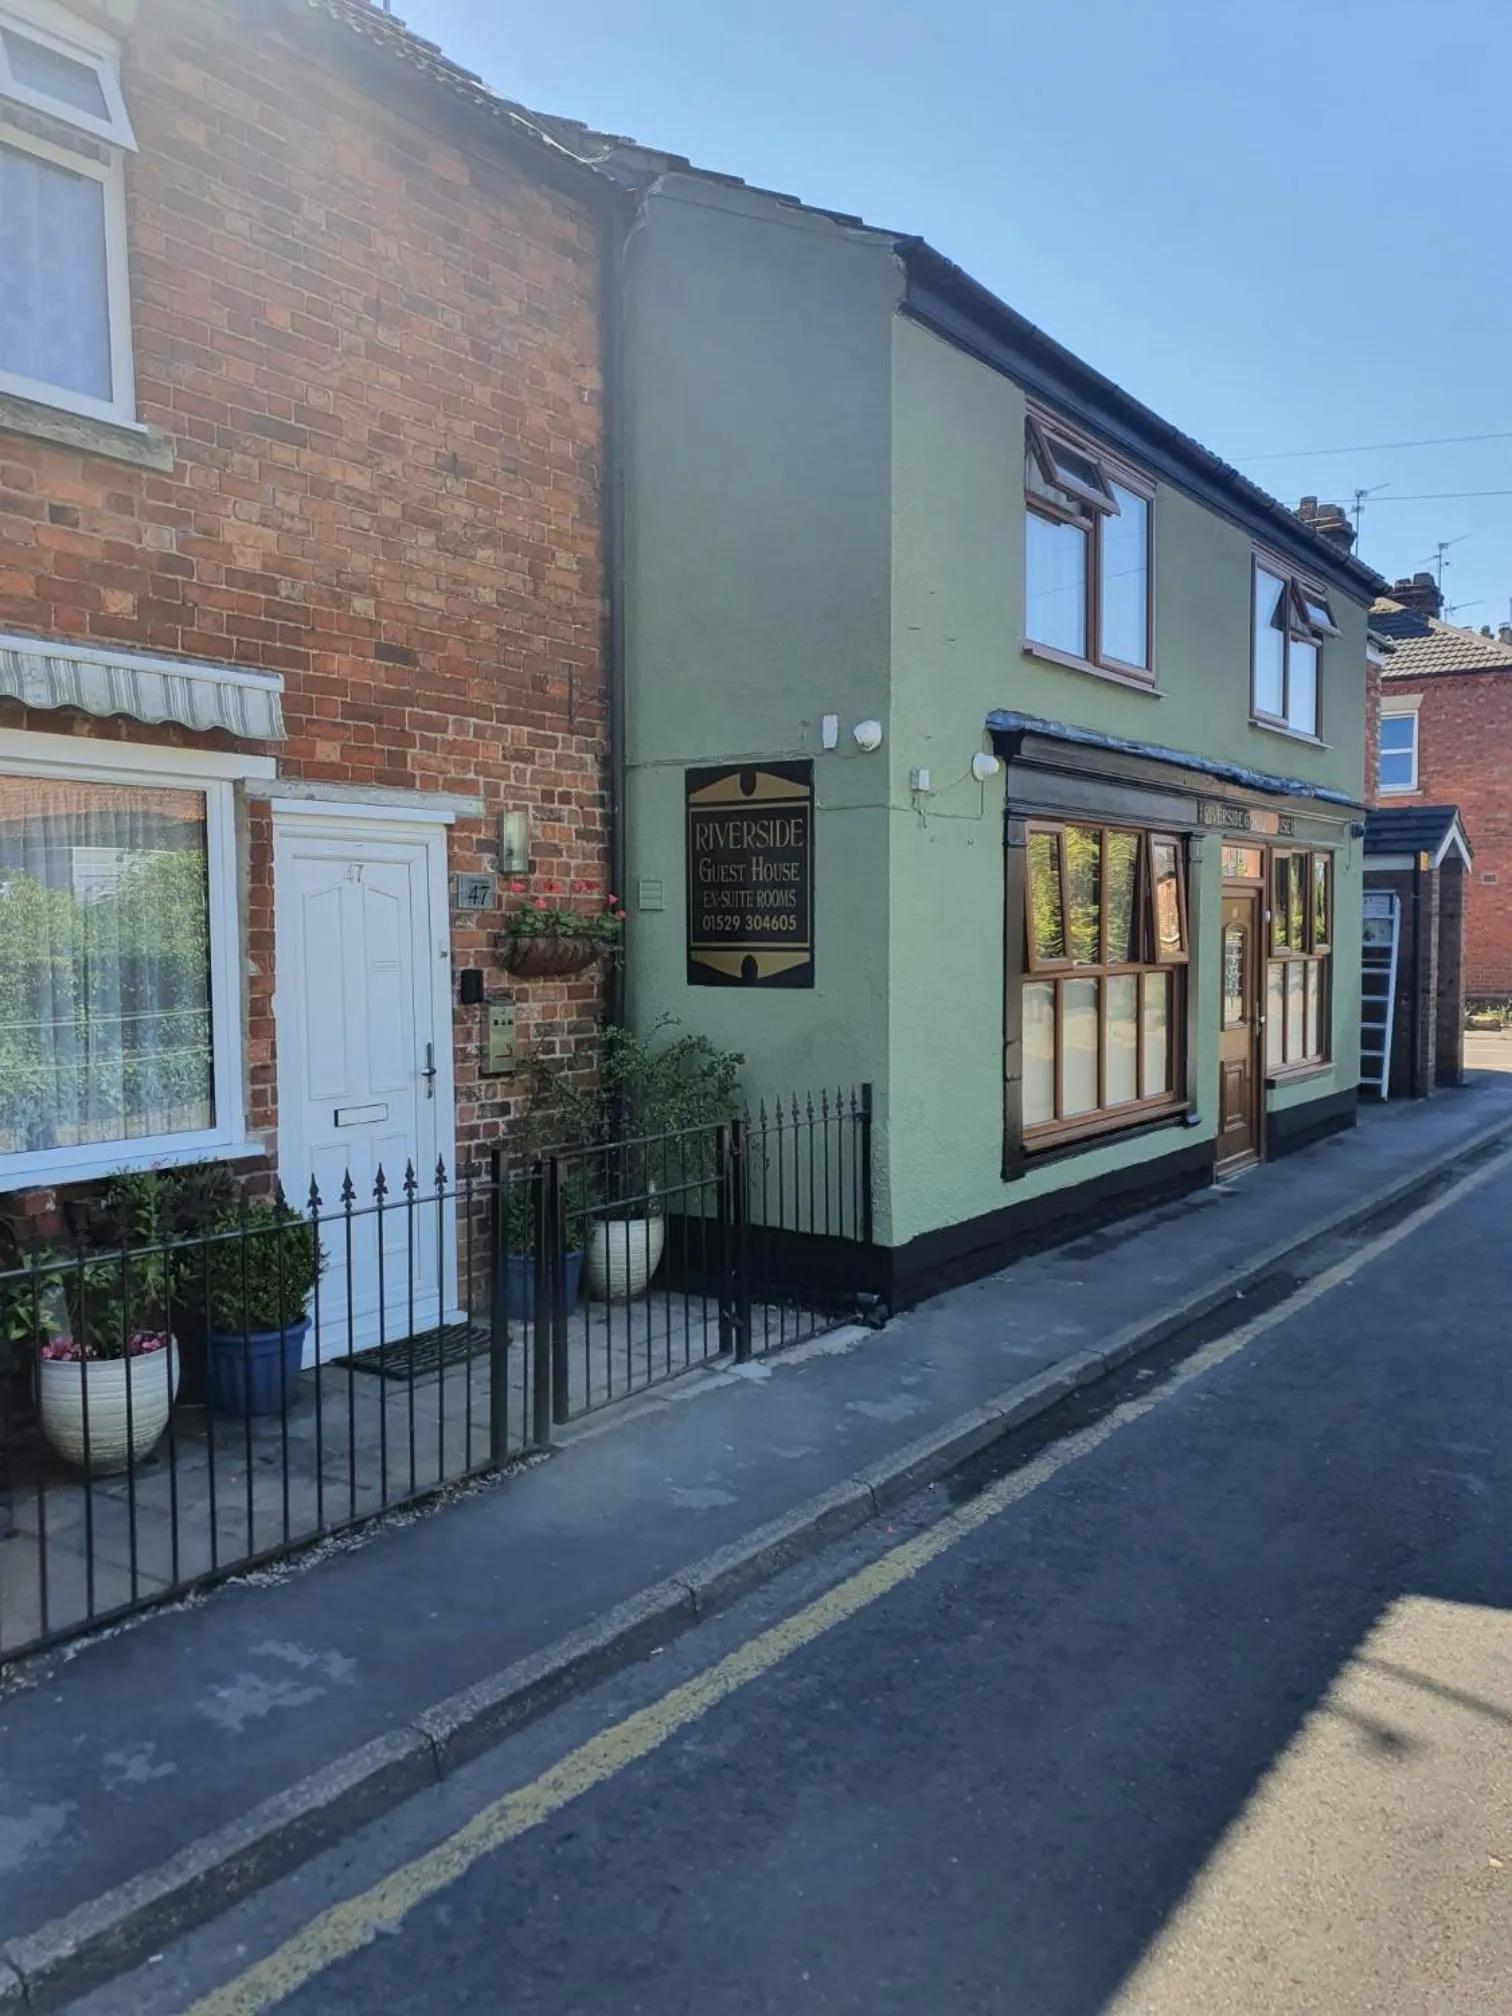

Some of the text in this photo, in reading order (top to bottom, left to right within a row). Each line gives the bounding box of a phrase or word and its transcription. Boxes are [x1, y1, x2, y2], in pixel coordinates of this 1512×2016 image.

[696, 819, 803, 851] RIVERSIDE
[699, 856, 800, 882] GUEST HOUSE
[466, 885, 489, 905] 47
[704, 888, 796, 909] EN-SUITE ROOMS
[702, 915, 797, 931] 01529 304605
